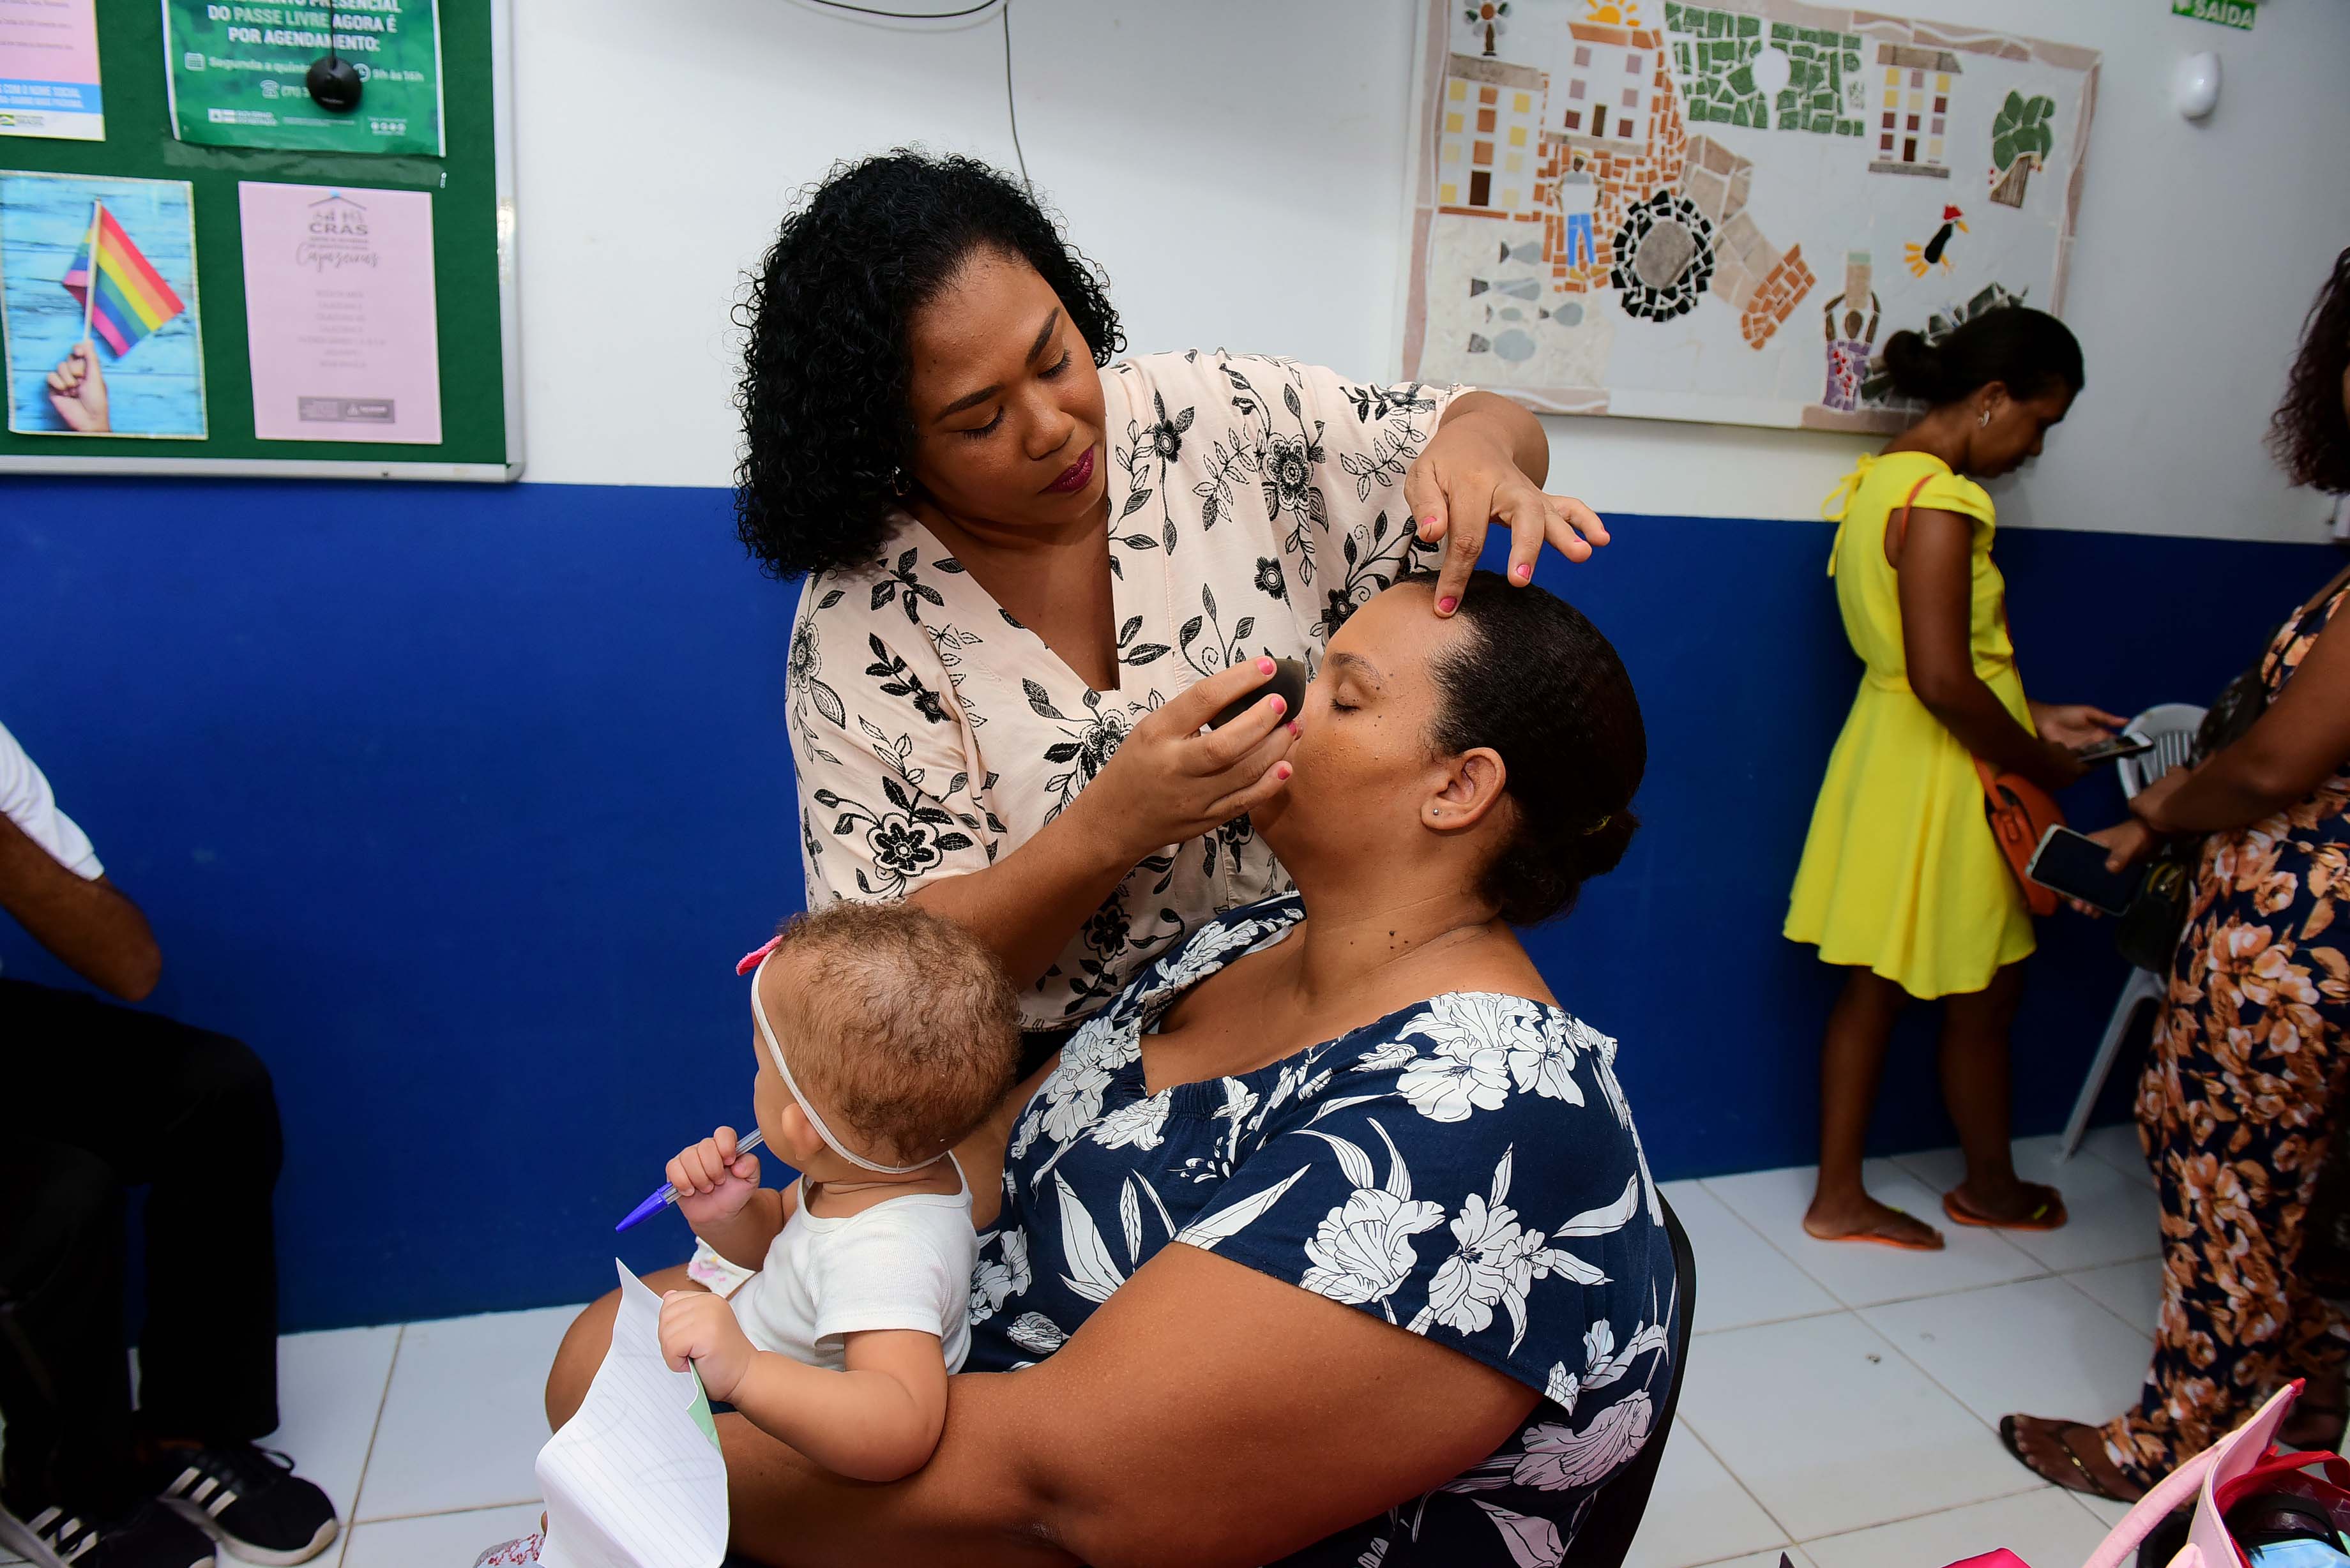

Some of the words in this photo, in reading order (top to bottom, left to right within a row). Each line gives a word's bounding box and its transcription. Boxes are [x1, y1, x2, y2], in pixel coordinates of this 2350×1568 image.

[208, 5, 231, 21] DO
[233, 6, 283, 25] PASSE
[285, 11, 330, 28] LIVRE
[333, 13, 384, 31] AGORA
[386, 14, 397, 33] É
[228, 26, 262, 43] POR
[309, 222, 368, 236] CRAS
